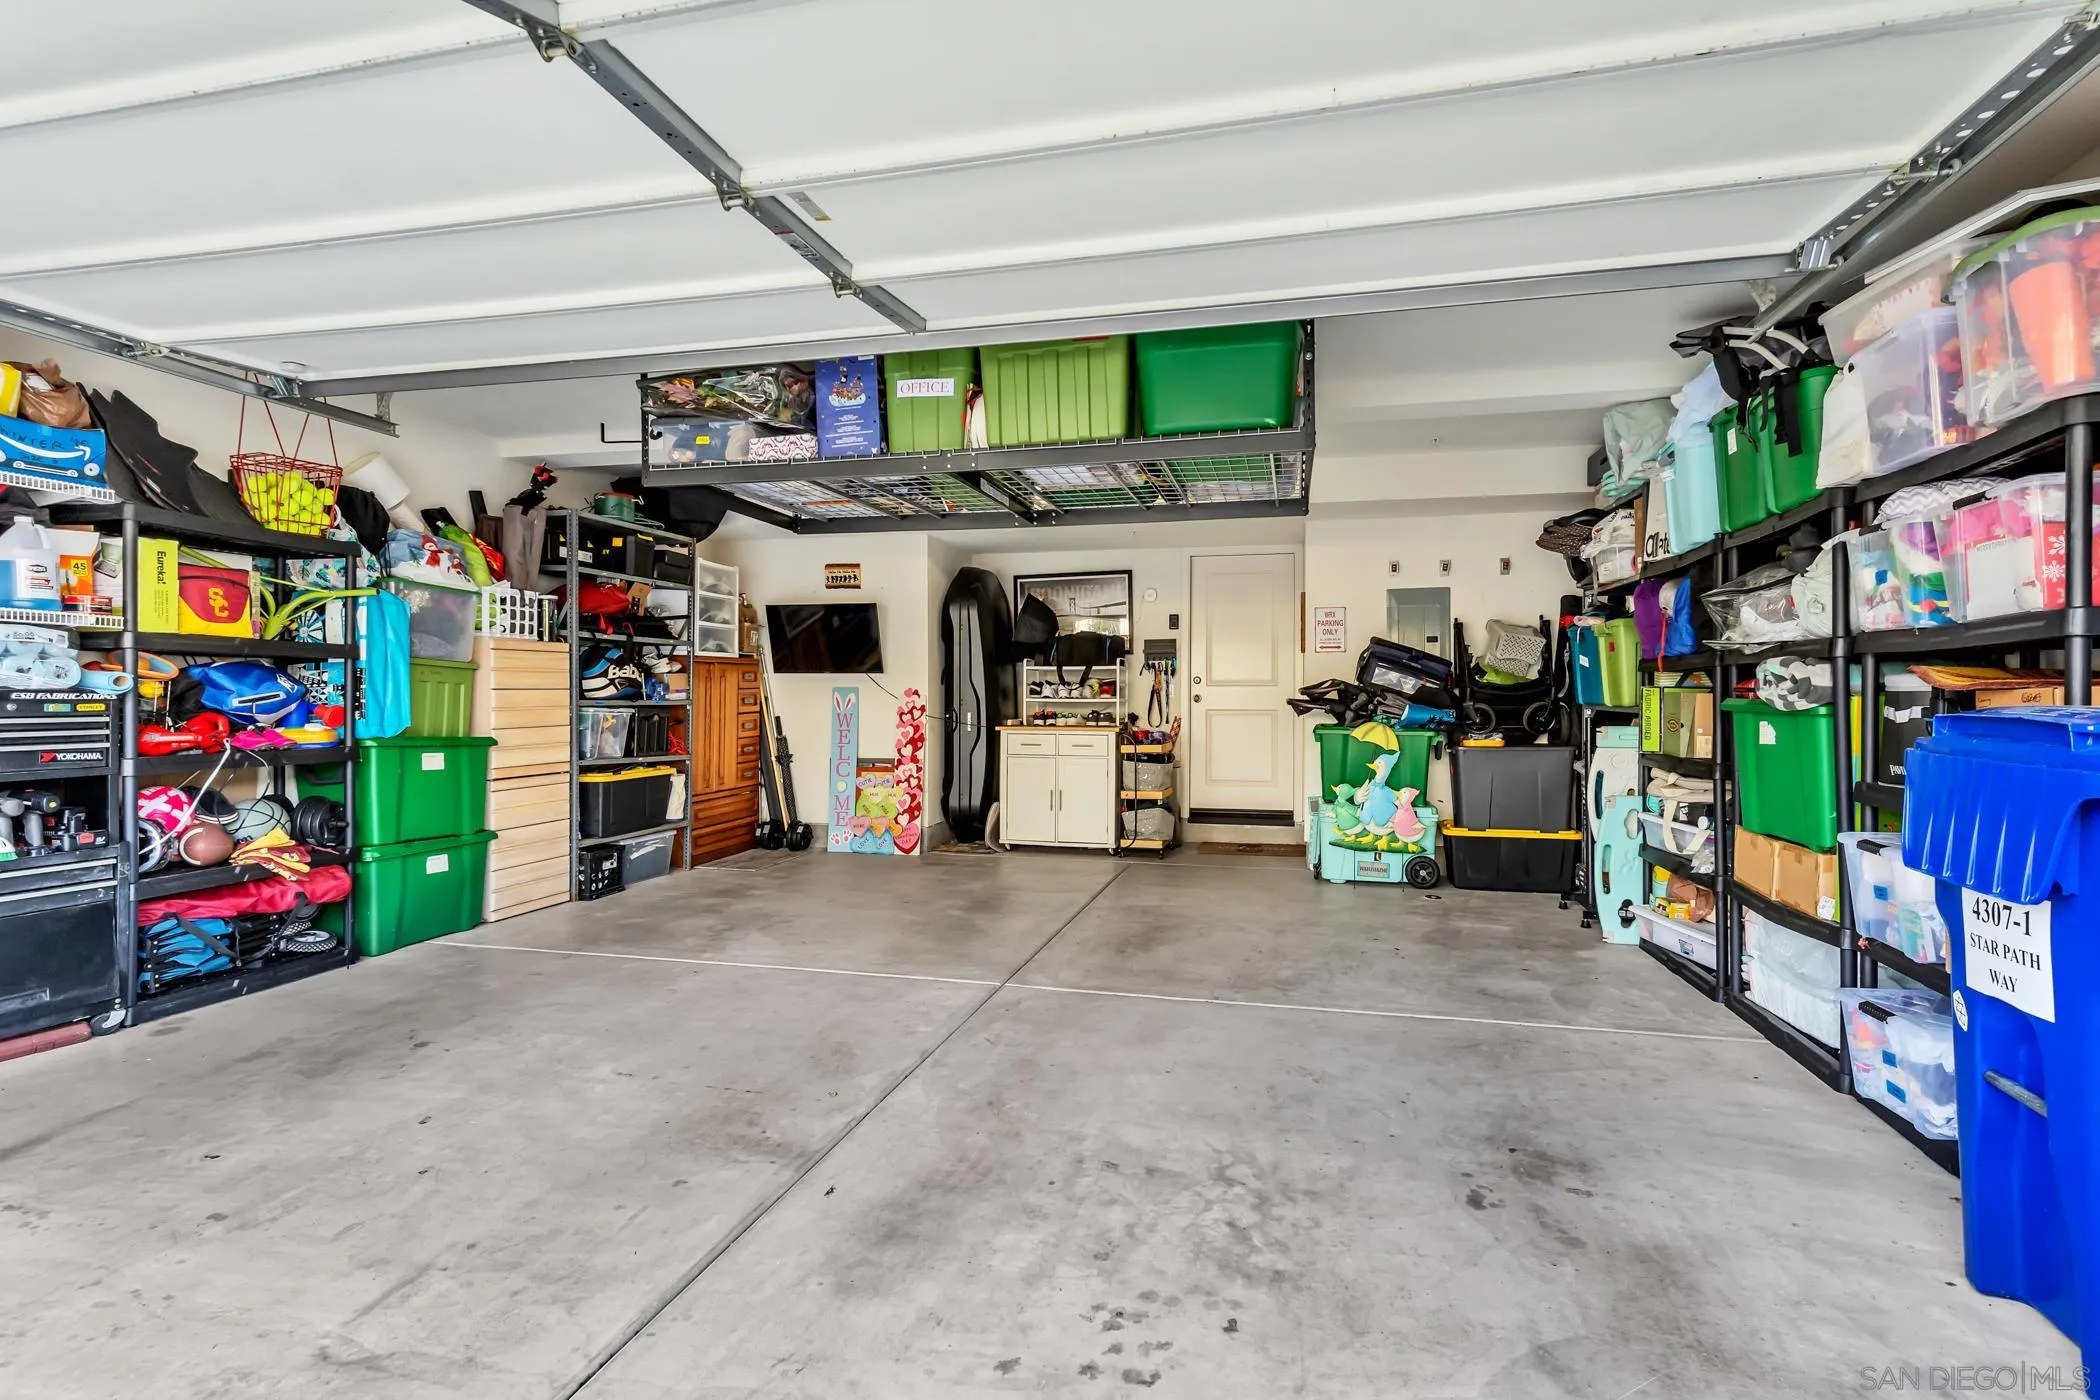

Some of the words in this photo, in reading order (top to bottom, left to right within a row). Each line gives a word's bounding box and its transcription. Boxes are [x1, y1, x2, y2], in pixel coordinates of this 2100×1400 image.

[900, 381, 950, 393] OFFICE
[72, 562, 87, 571] 45
[156, 550, 166, 585] Eureka!
[1317, 619, 1344, 627] PARKING
[1322, 628, 1338, 636] ONLY
[56, 752, 103, 760] YOKOHAMA
[1972, 896, 2031, 936] 4307-1
[1969, 932, 2000, 957] STAR
[2002, 944, 2041, 971] PATH
[1989, 968, 2018, 993] WAY
